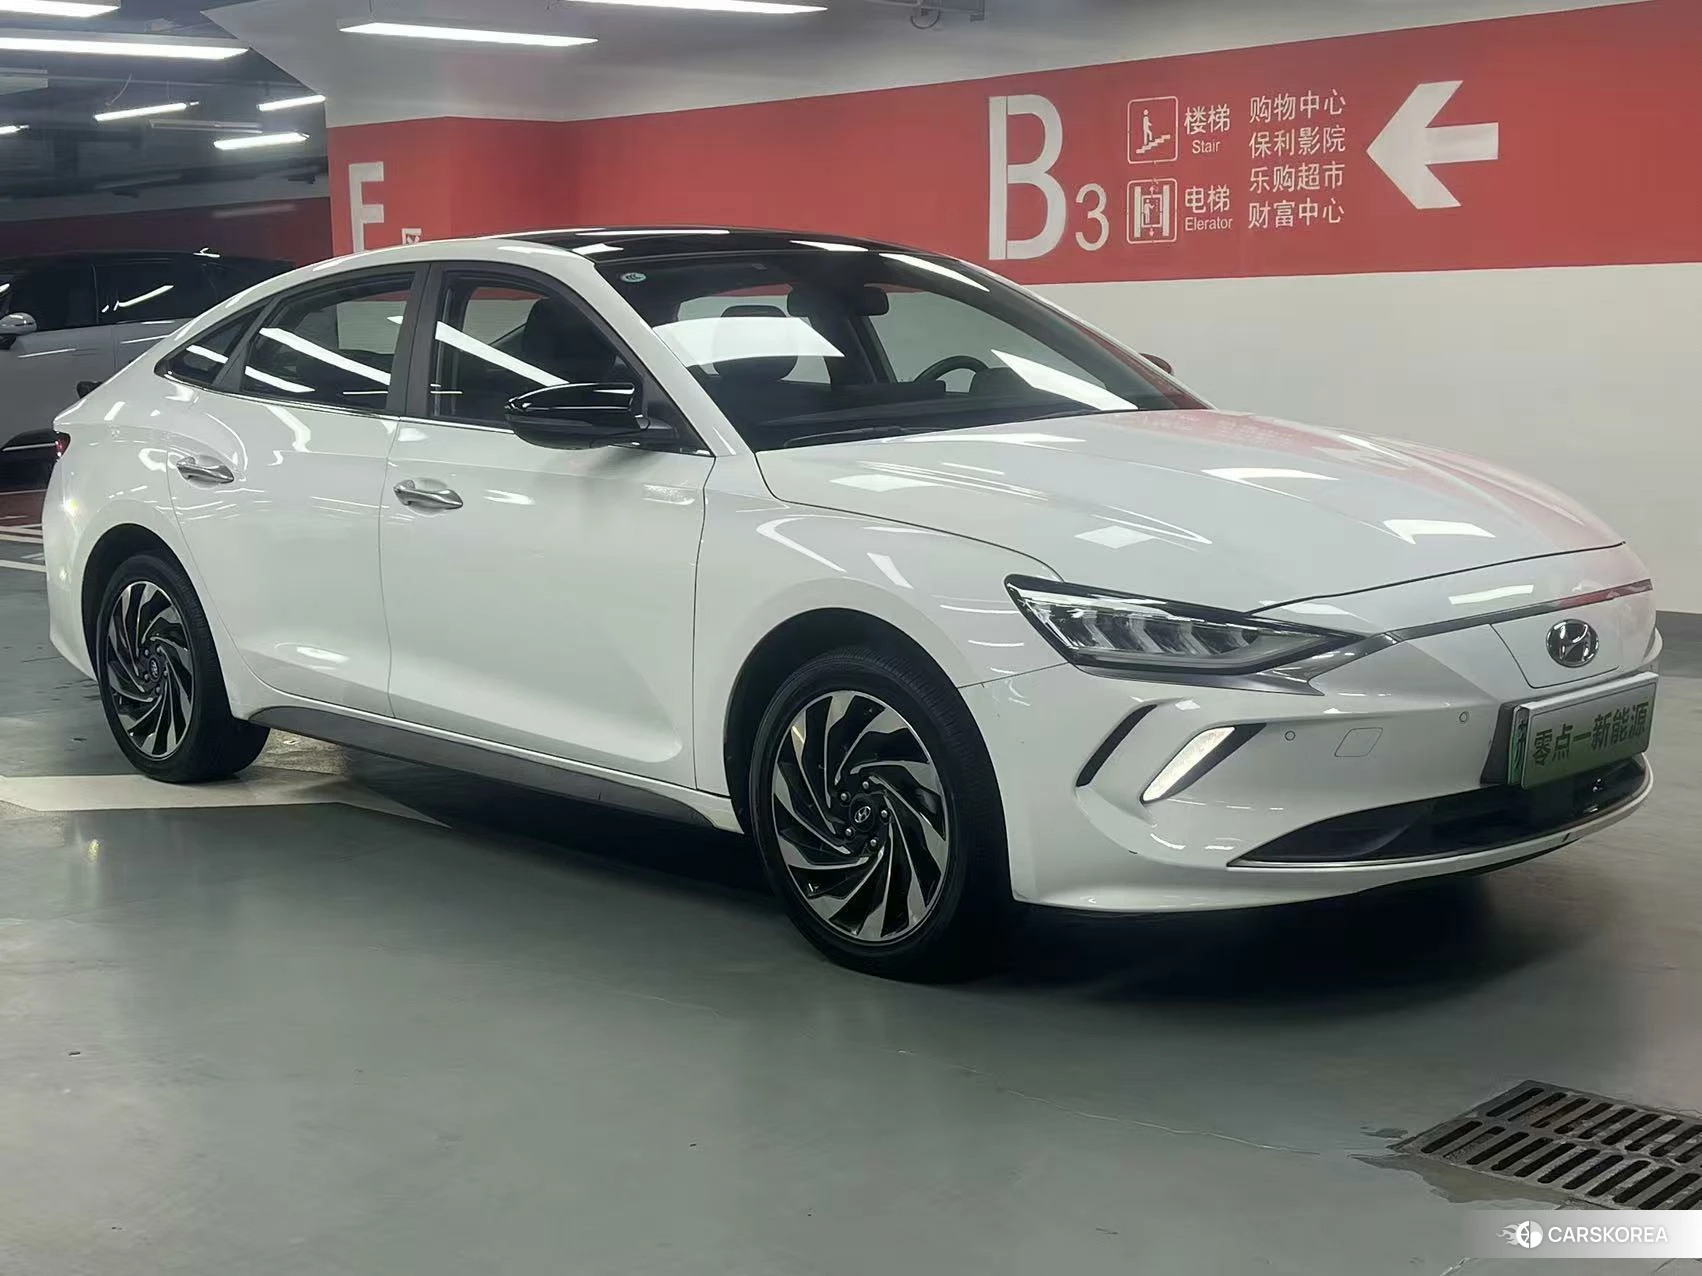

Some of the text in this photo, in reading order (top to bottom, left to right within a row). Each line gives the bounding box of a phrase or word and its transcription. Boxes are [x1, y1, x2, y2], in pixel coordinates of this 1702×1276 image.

[1184, 103, 1230, 135] 楼梯
[1249, 89, 1346, 123] 购物中心
[1192, 139, 1221, 154] Stair
[1249, 124, 1346, 159] 保利影院
[1249, 160, 1346, 194] 乐购超市
[1184, 184, 1230, 214] 电梯
[1248, 197, 1345, 229] 财富中心
[1533, 701, 1649, 766] 零点一新能源
